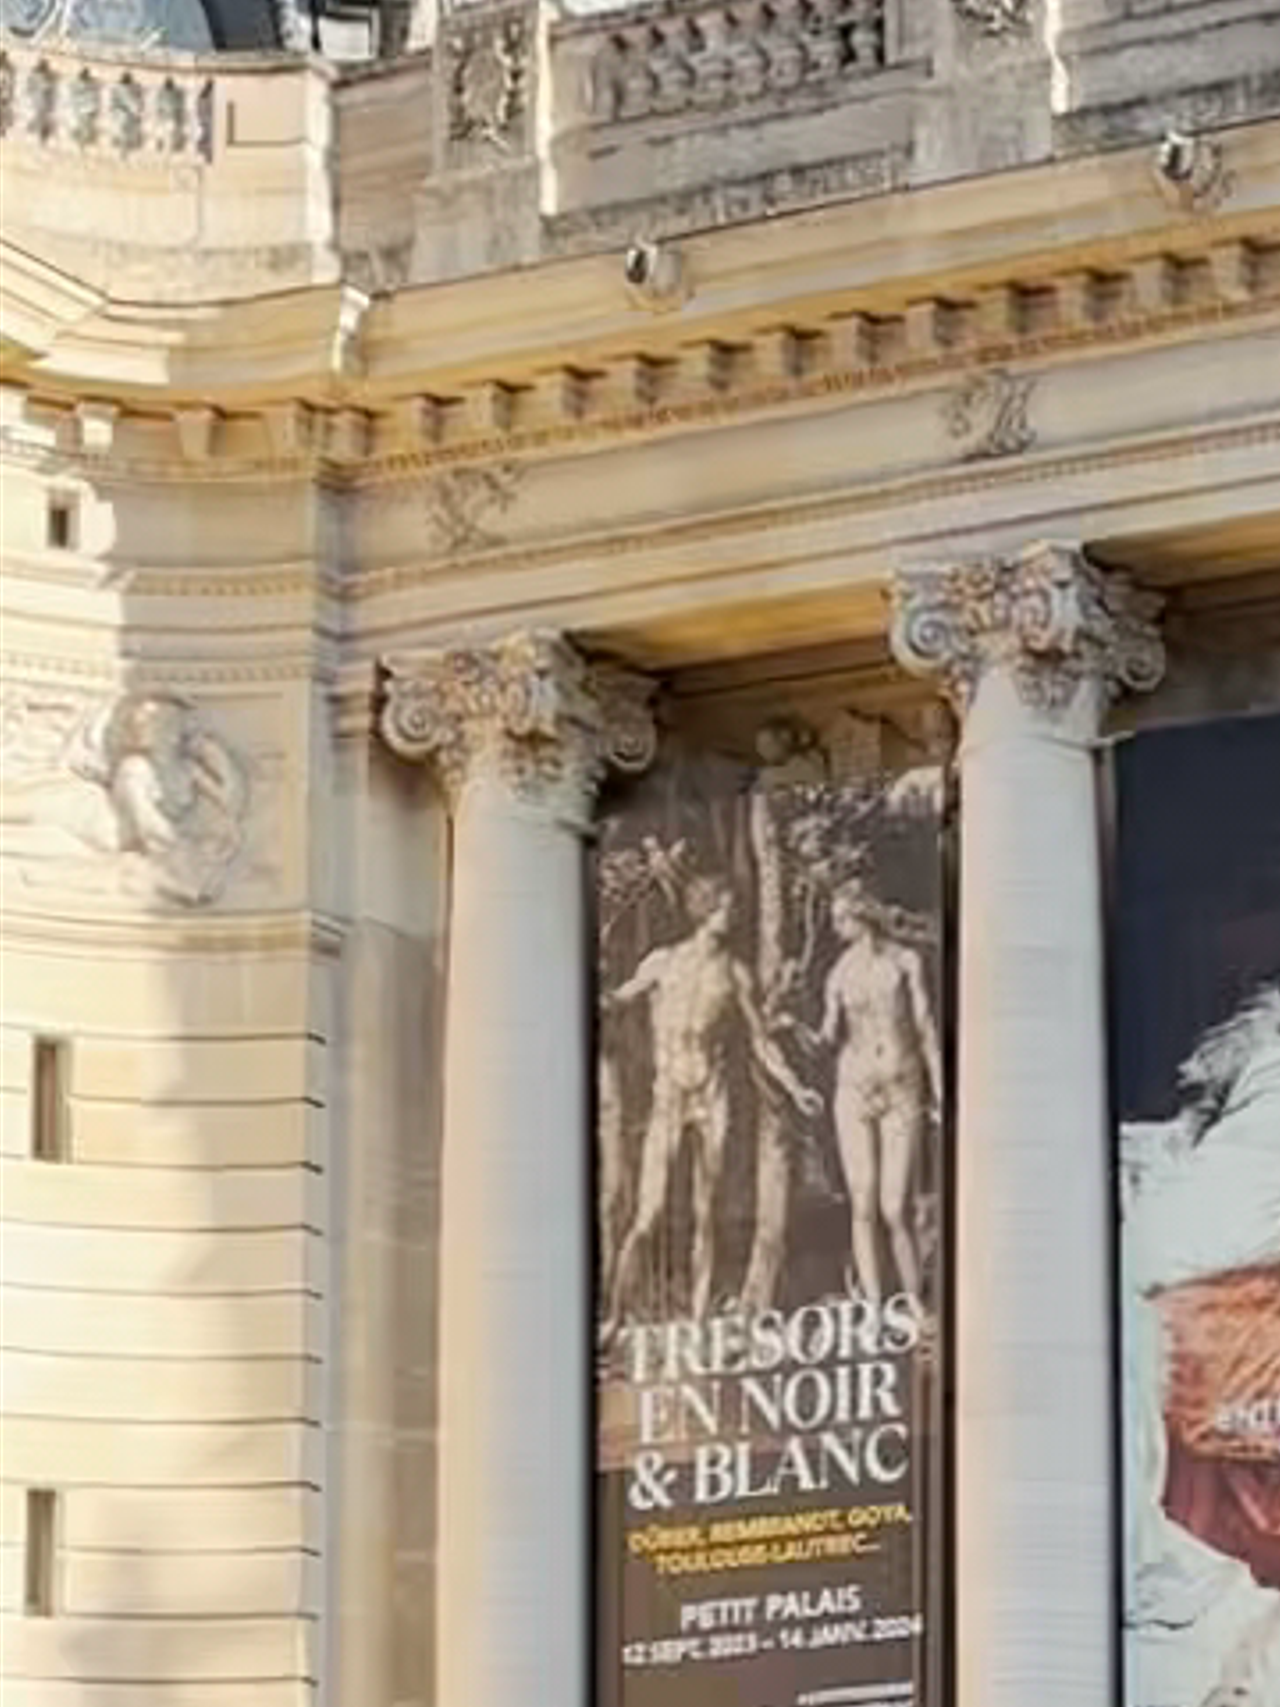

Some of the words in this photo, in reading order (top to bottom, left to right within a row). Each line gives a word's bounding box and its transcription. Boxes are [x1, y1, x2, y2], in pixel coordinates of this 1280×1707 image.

[618, 1291, 918, 1383] TRÉSORS
[639, 1379, 723, 1444] EN
[740, 1360, 901, 1435] NOIR
[627, 1450, 682, 1511] &
[694, 1423, 909, 1504] BLANC
[680, 1596, 759, 1632] PETIT
[764, 1584, 862, 1622] PALAIS
